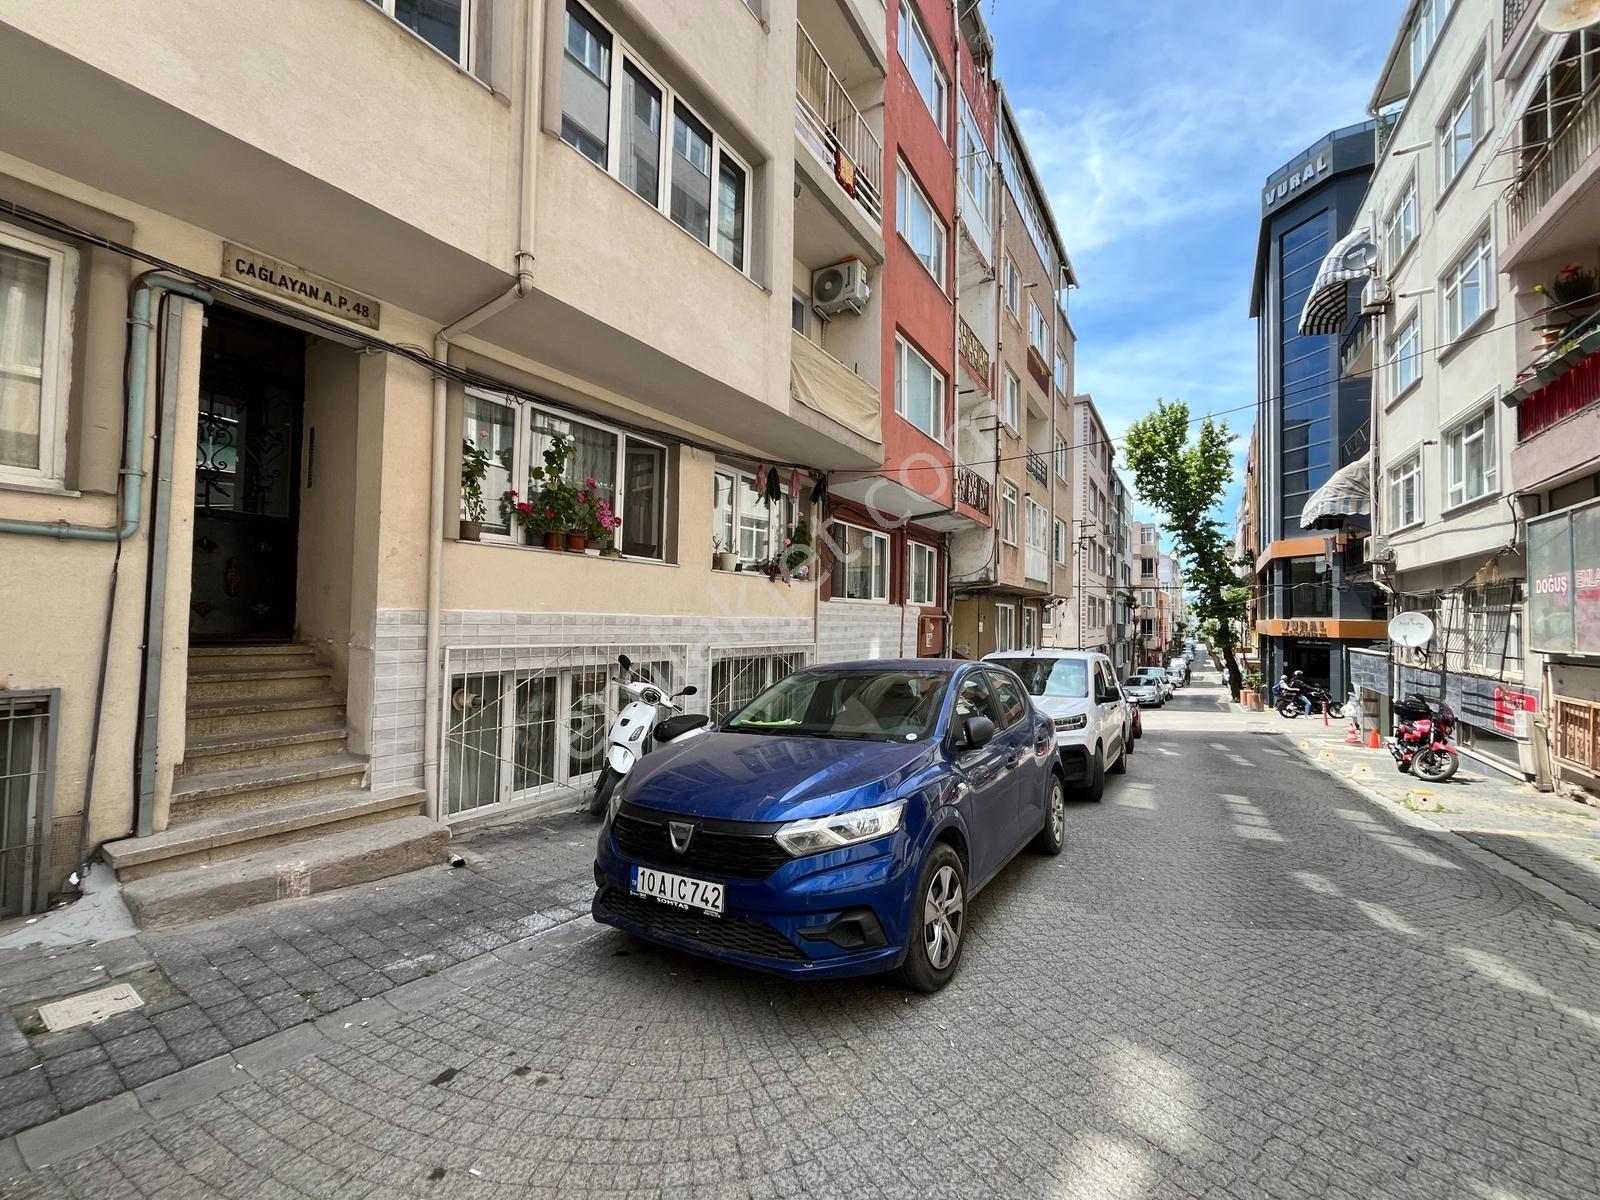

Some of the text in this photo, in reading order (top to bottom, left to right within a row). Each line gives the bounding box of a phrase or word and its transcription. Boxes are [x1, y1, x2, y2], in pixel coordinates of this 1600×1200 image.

[1265, 157, 1327, 206] VURAL
[235, 258, 319, 300] ÇAĞLAYAN
[1535, 574, 1568, 596] DOĞUŞ
[640, 870, 721, 909] 10AIC742
